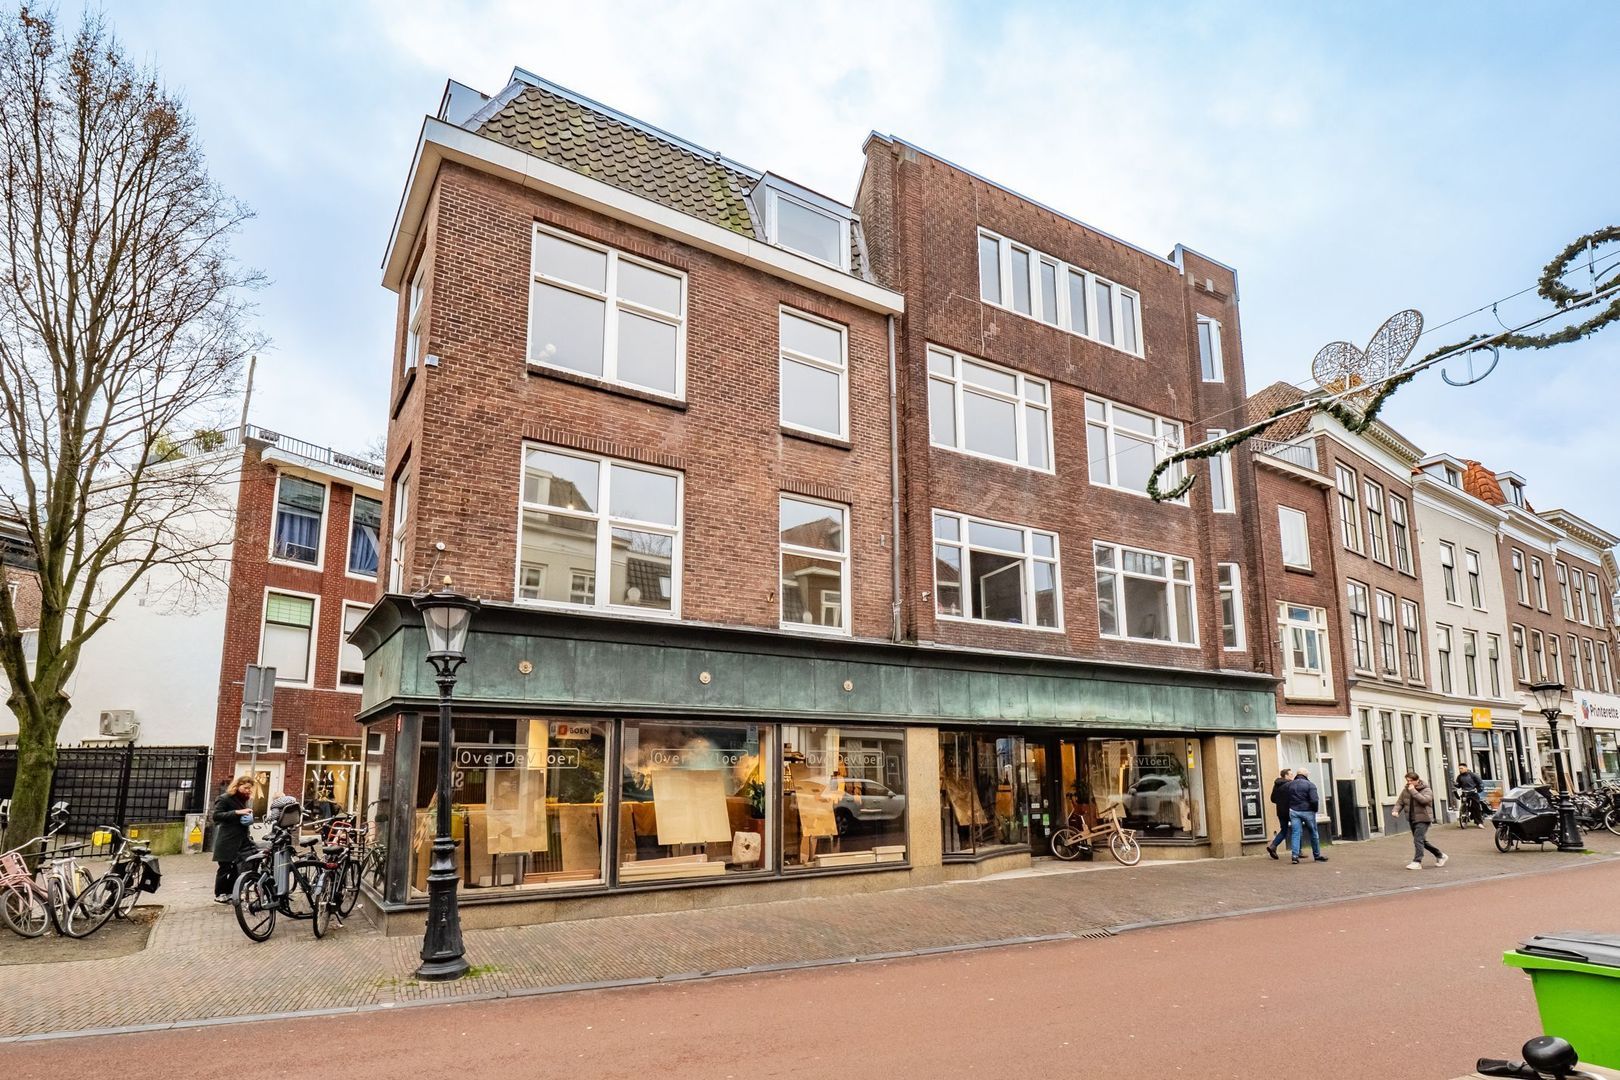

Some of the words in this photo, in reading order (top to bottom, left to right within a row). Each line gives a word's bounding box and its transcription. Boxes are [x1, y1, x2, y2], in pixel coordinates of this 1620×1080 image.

[1590, 704, 1619, 719] Printerette
[569, 727, 589, 735] BOEN
[654, 752, 745, 765] OverVloer
[809, 754, 882, 765] OvDeVloer
